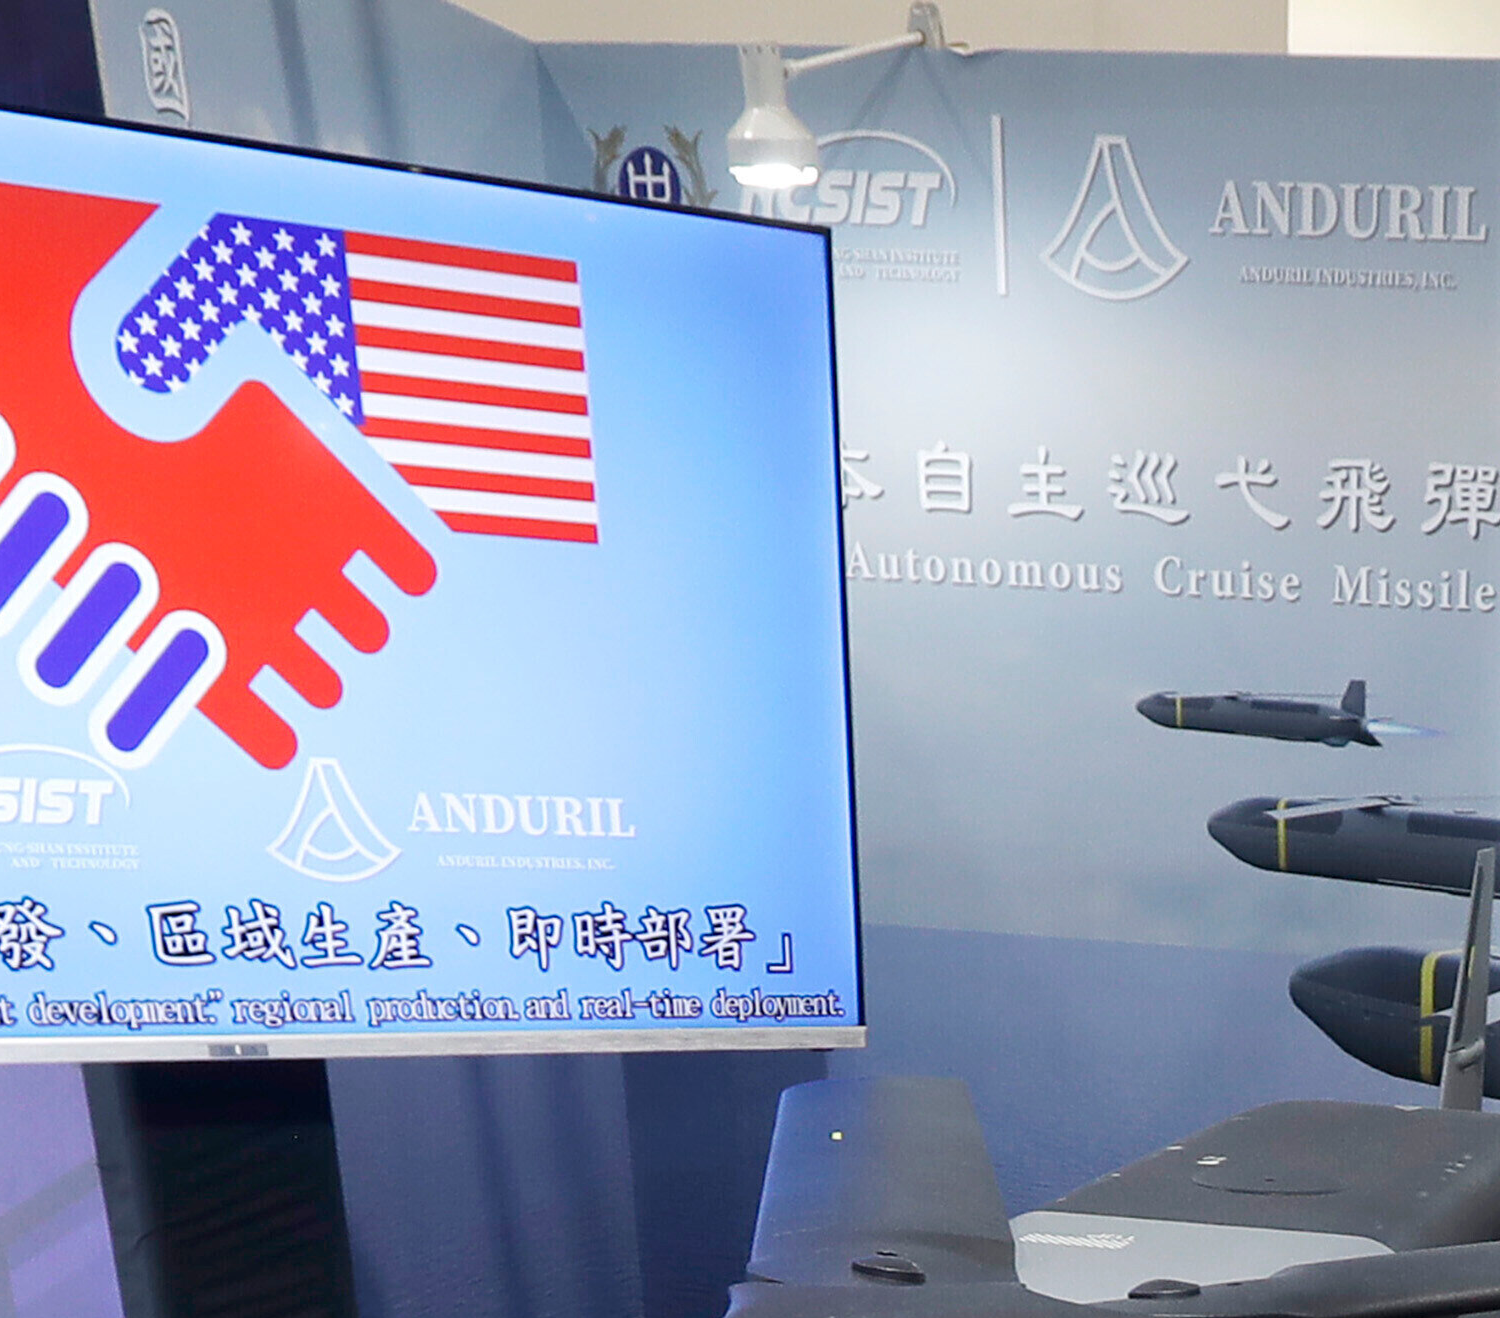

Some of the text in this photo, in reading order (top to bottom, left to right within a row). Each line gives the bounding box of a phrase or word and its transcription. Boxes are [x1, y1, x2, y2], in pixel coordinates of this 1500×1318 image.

[1208, 178, 1489, 243] ANDURIL
[1239, 266, 1313, 284] ANDURIL
[847, 541, 1498, 613] Autonomous Cruise Missile
[407, 791, 637, 838] ANDURIL
[10, 857, 41, 868] AND
[51, 857, 140, 869] TECHNOLOGY
[66, 843, 140, 856] INSTITUTE
[437, 854, 498, 867] ANDURIL
[231, 988, 356, 1028] regional
[523, 987, 575, 1022] and
[579, 987, 702, 1021] real-time
[710, 986, 845, 1024] deployment.
